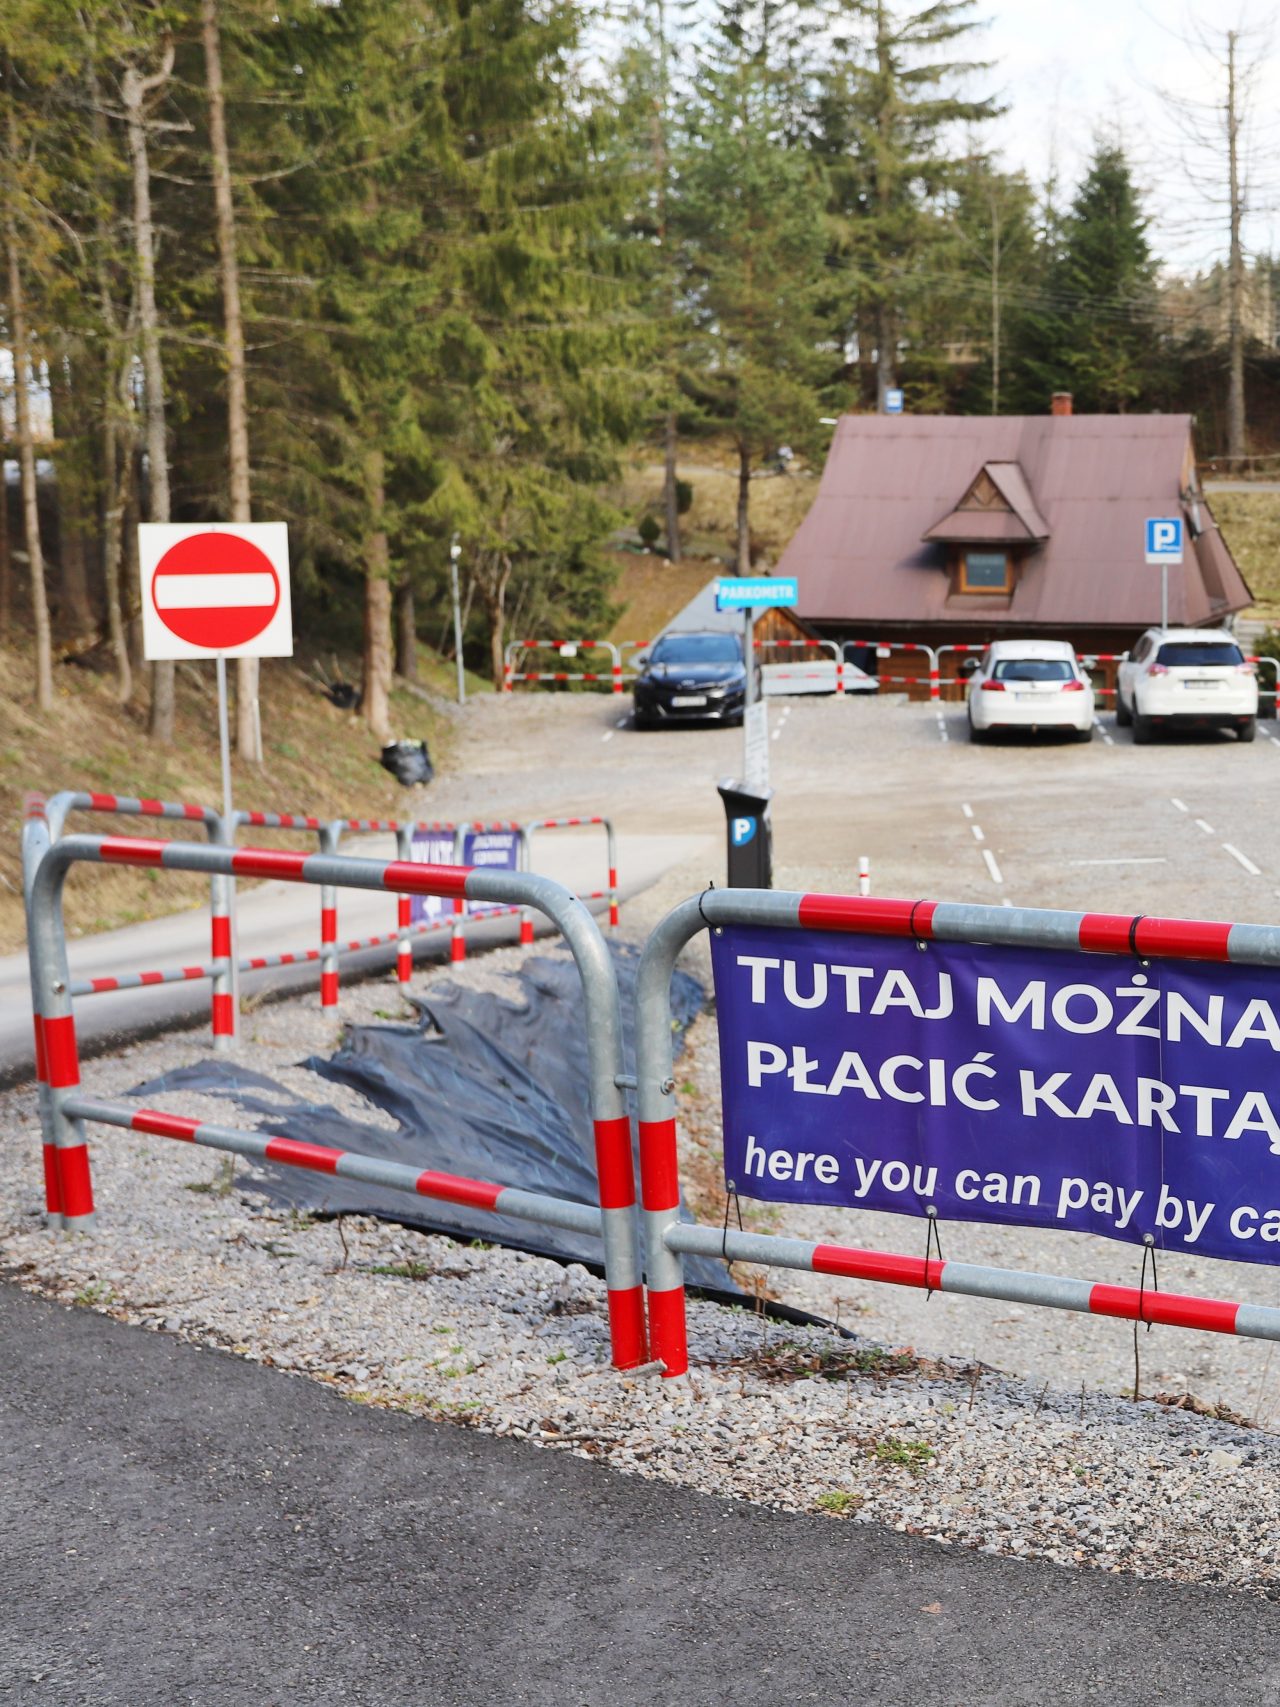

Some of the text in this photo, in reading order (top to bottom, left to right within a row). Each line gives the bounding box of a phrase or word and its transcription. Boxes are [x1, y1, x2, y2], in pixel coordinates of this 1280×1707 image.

[1153, 522, 1176, 552] P
[721, 585, 794, 600] PARKOMETR
[733, 818, 751, 842] P
[736, 955, 954, 1020] TUTAJ
[746, 1040, 1001, 1111] PŁACIĆ
[744, 1135, 840, 1184] here
[854, 1157, 938, 1198] you
[954, 1169, 1041, 1206] can
[1056, 1177, 1144, 1229] pay
[1154, 1183, 1216, 1243] by
